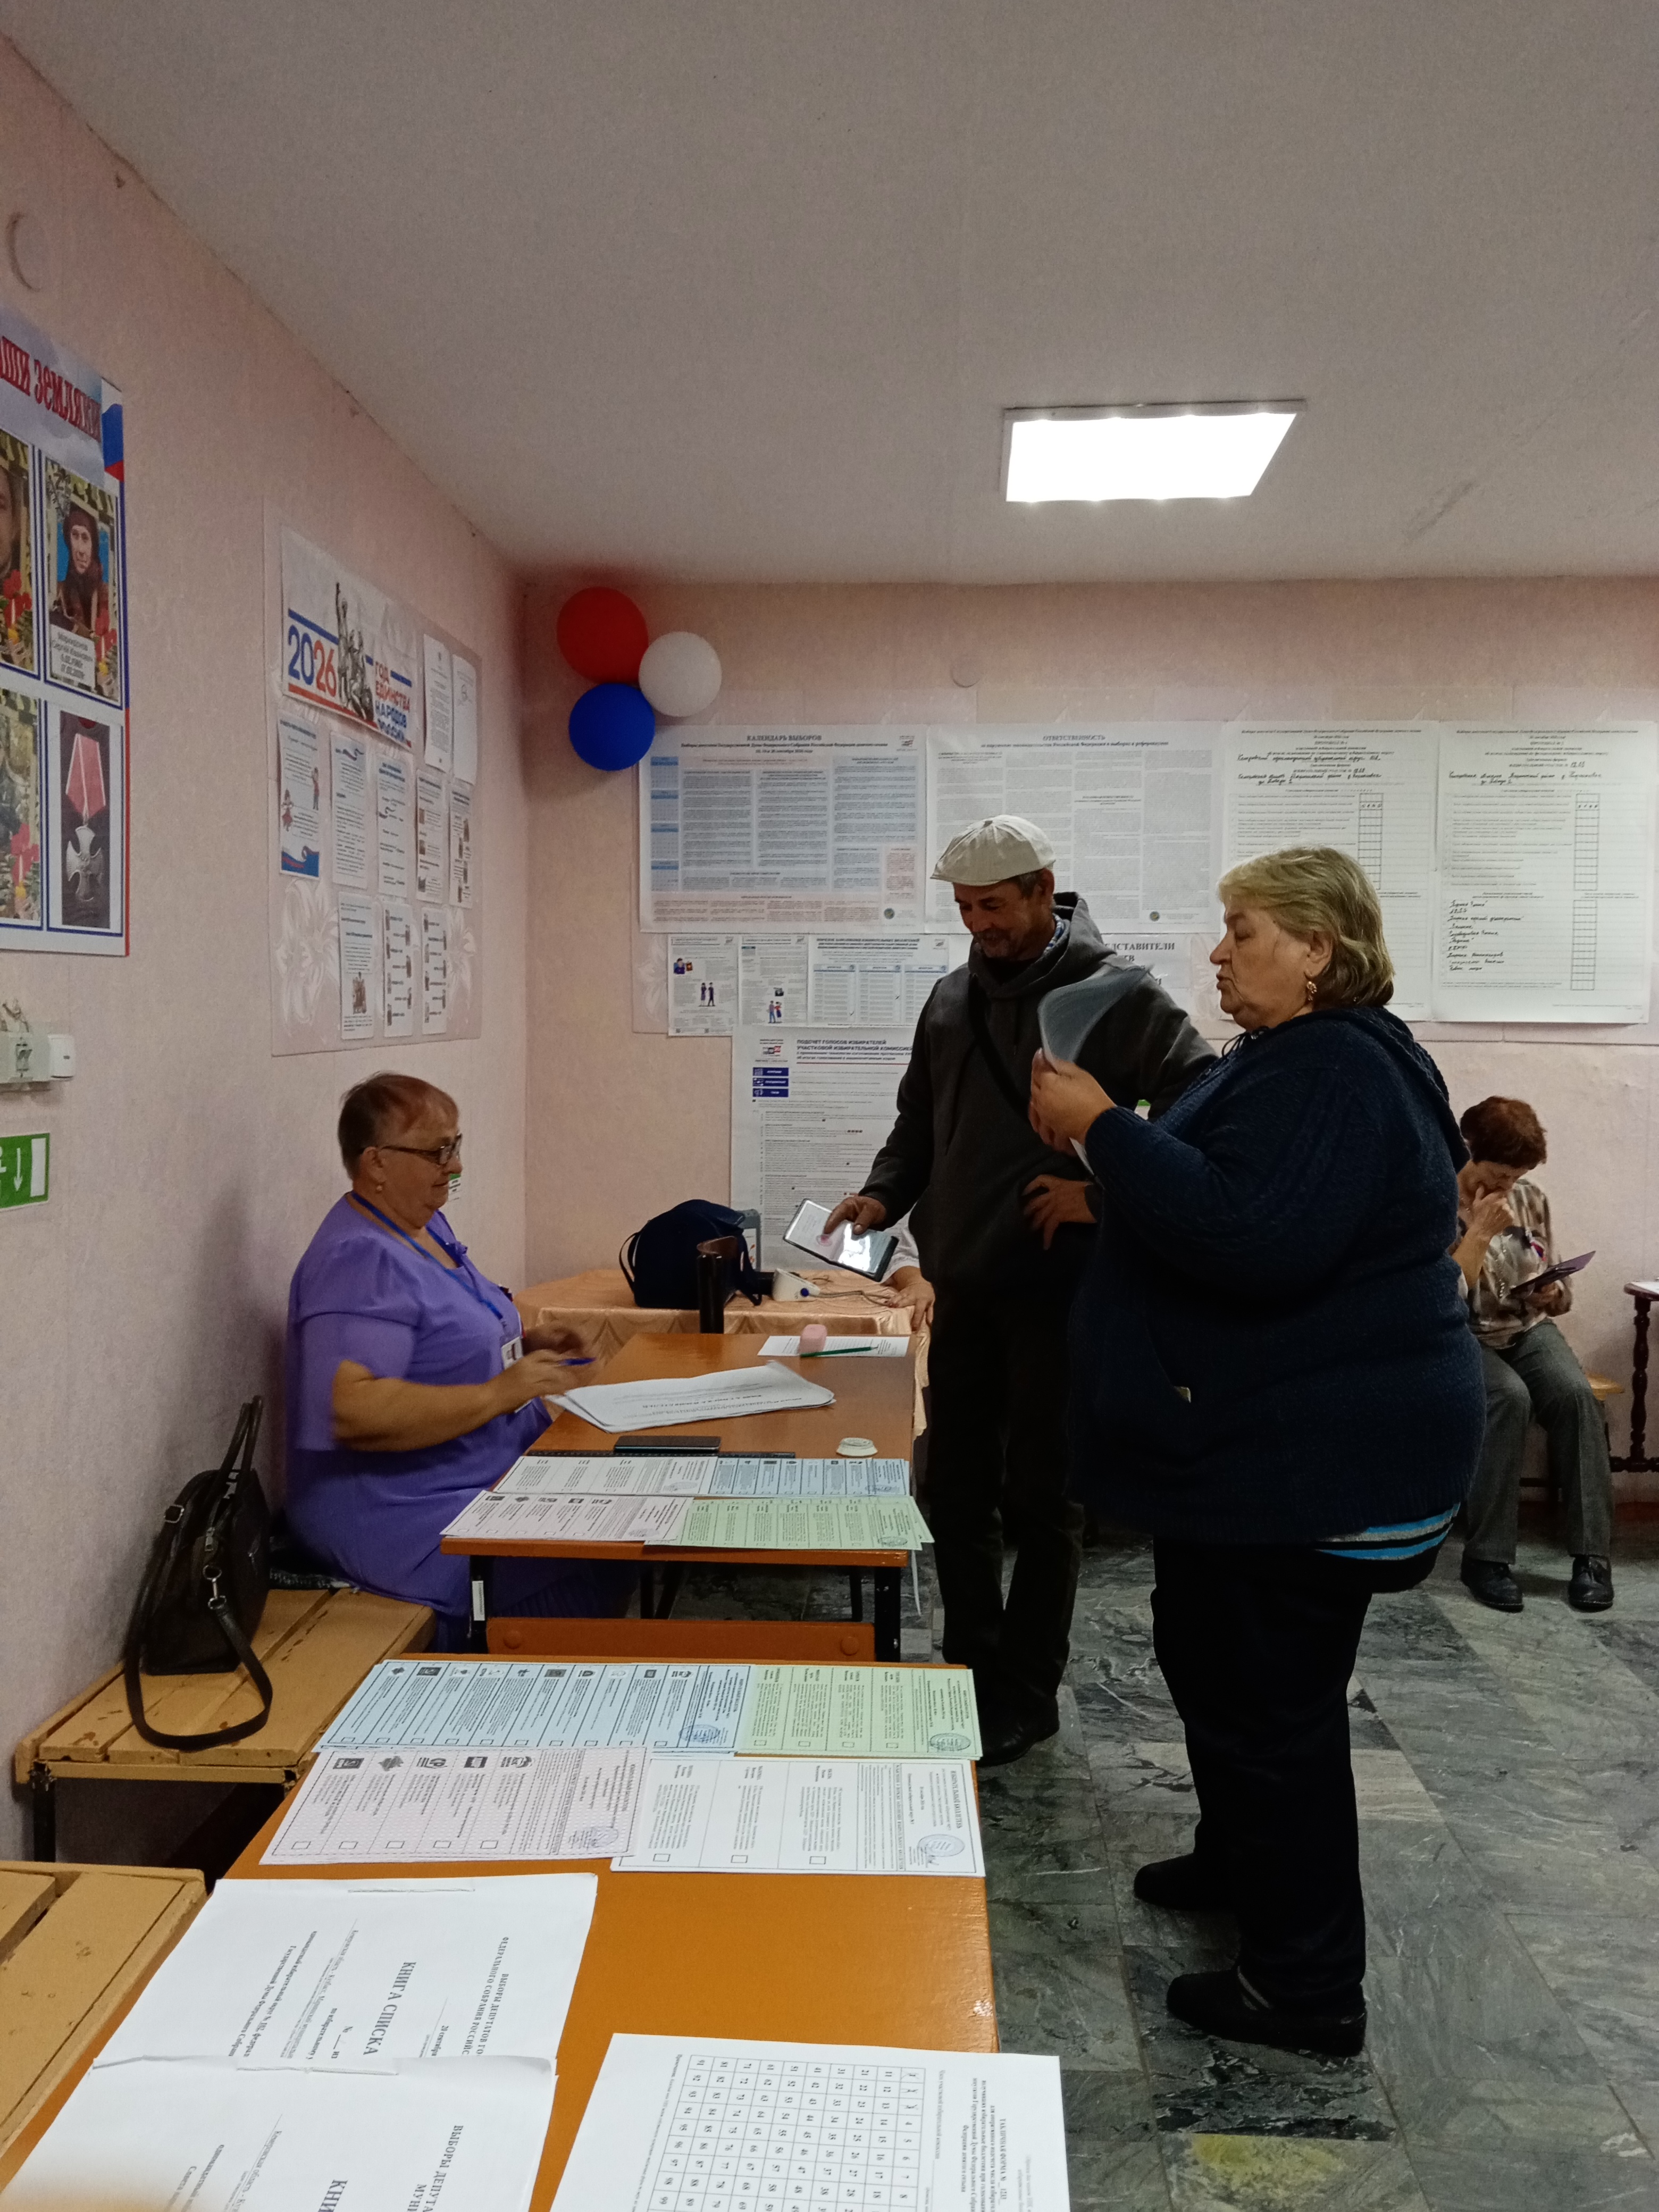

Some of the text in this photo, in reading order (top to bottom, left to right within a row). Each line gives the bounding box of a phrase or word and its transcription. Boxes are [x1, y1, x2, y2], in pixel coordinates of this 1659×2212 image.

[288, 625, 337, 698] 2026
[363, 1961, 417, 2056] КНИГА СПИСКА
[462, 1936, 509, 2055] ФЕДЕРАЛЬНОГО СОБРАНИЯ РОССИЙС
[475, 1973, 509, 2057] ВЫБОРЫ ДЕПУТАТОВ ГО
[330, 2050, 340, 2059] из
[431, 2032, 445, 2057] сентября
[176, 2165, 197, 2191] Совета
[316, 2179, 340, 2212] КНИ
[422, 2125, 464, 2212] ВЫБОРЫ ДЕПУТА
